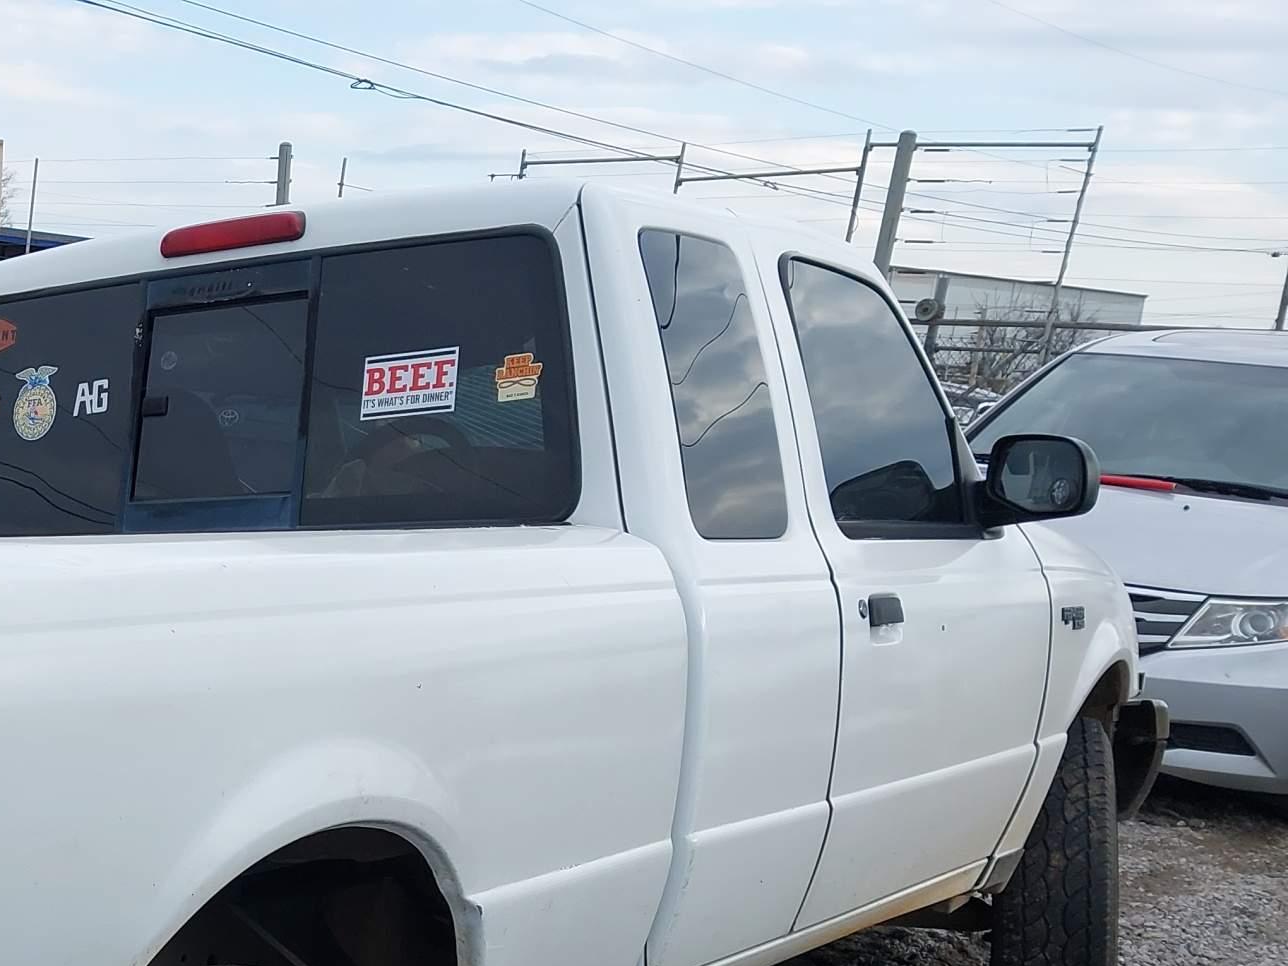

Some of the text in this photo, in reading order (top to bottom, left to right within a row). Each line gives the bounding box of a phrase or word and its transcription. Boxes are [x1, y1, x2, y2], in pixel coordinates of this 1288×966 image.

[364, 359, 456, 396] BEEF.
[27, 399, 43, 407] FFA
[73, 378, 109, 417] AG
[363, 398, 376, 409] IT'S
[377, 396, 404, 408] WHAT'S
[406, 394, 420, 405] FOR
